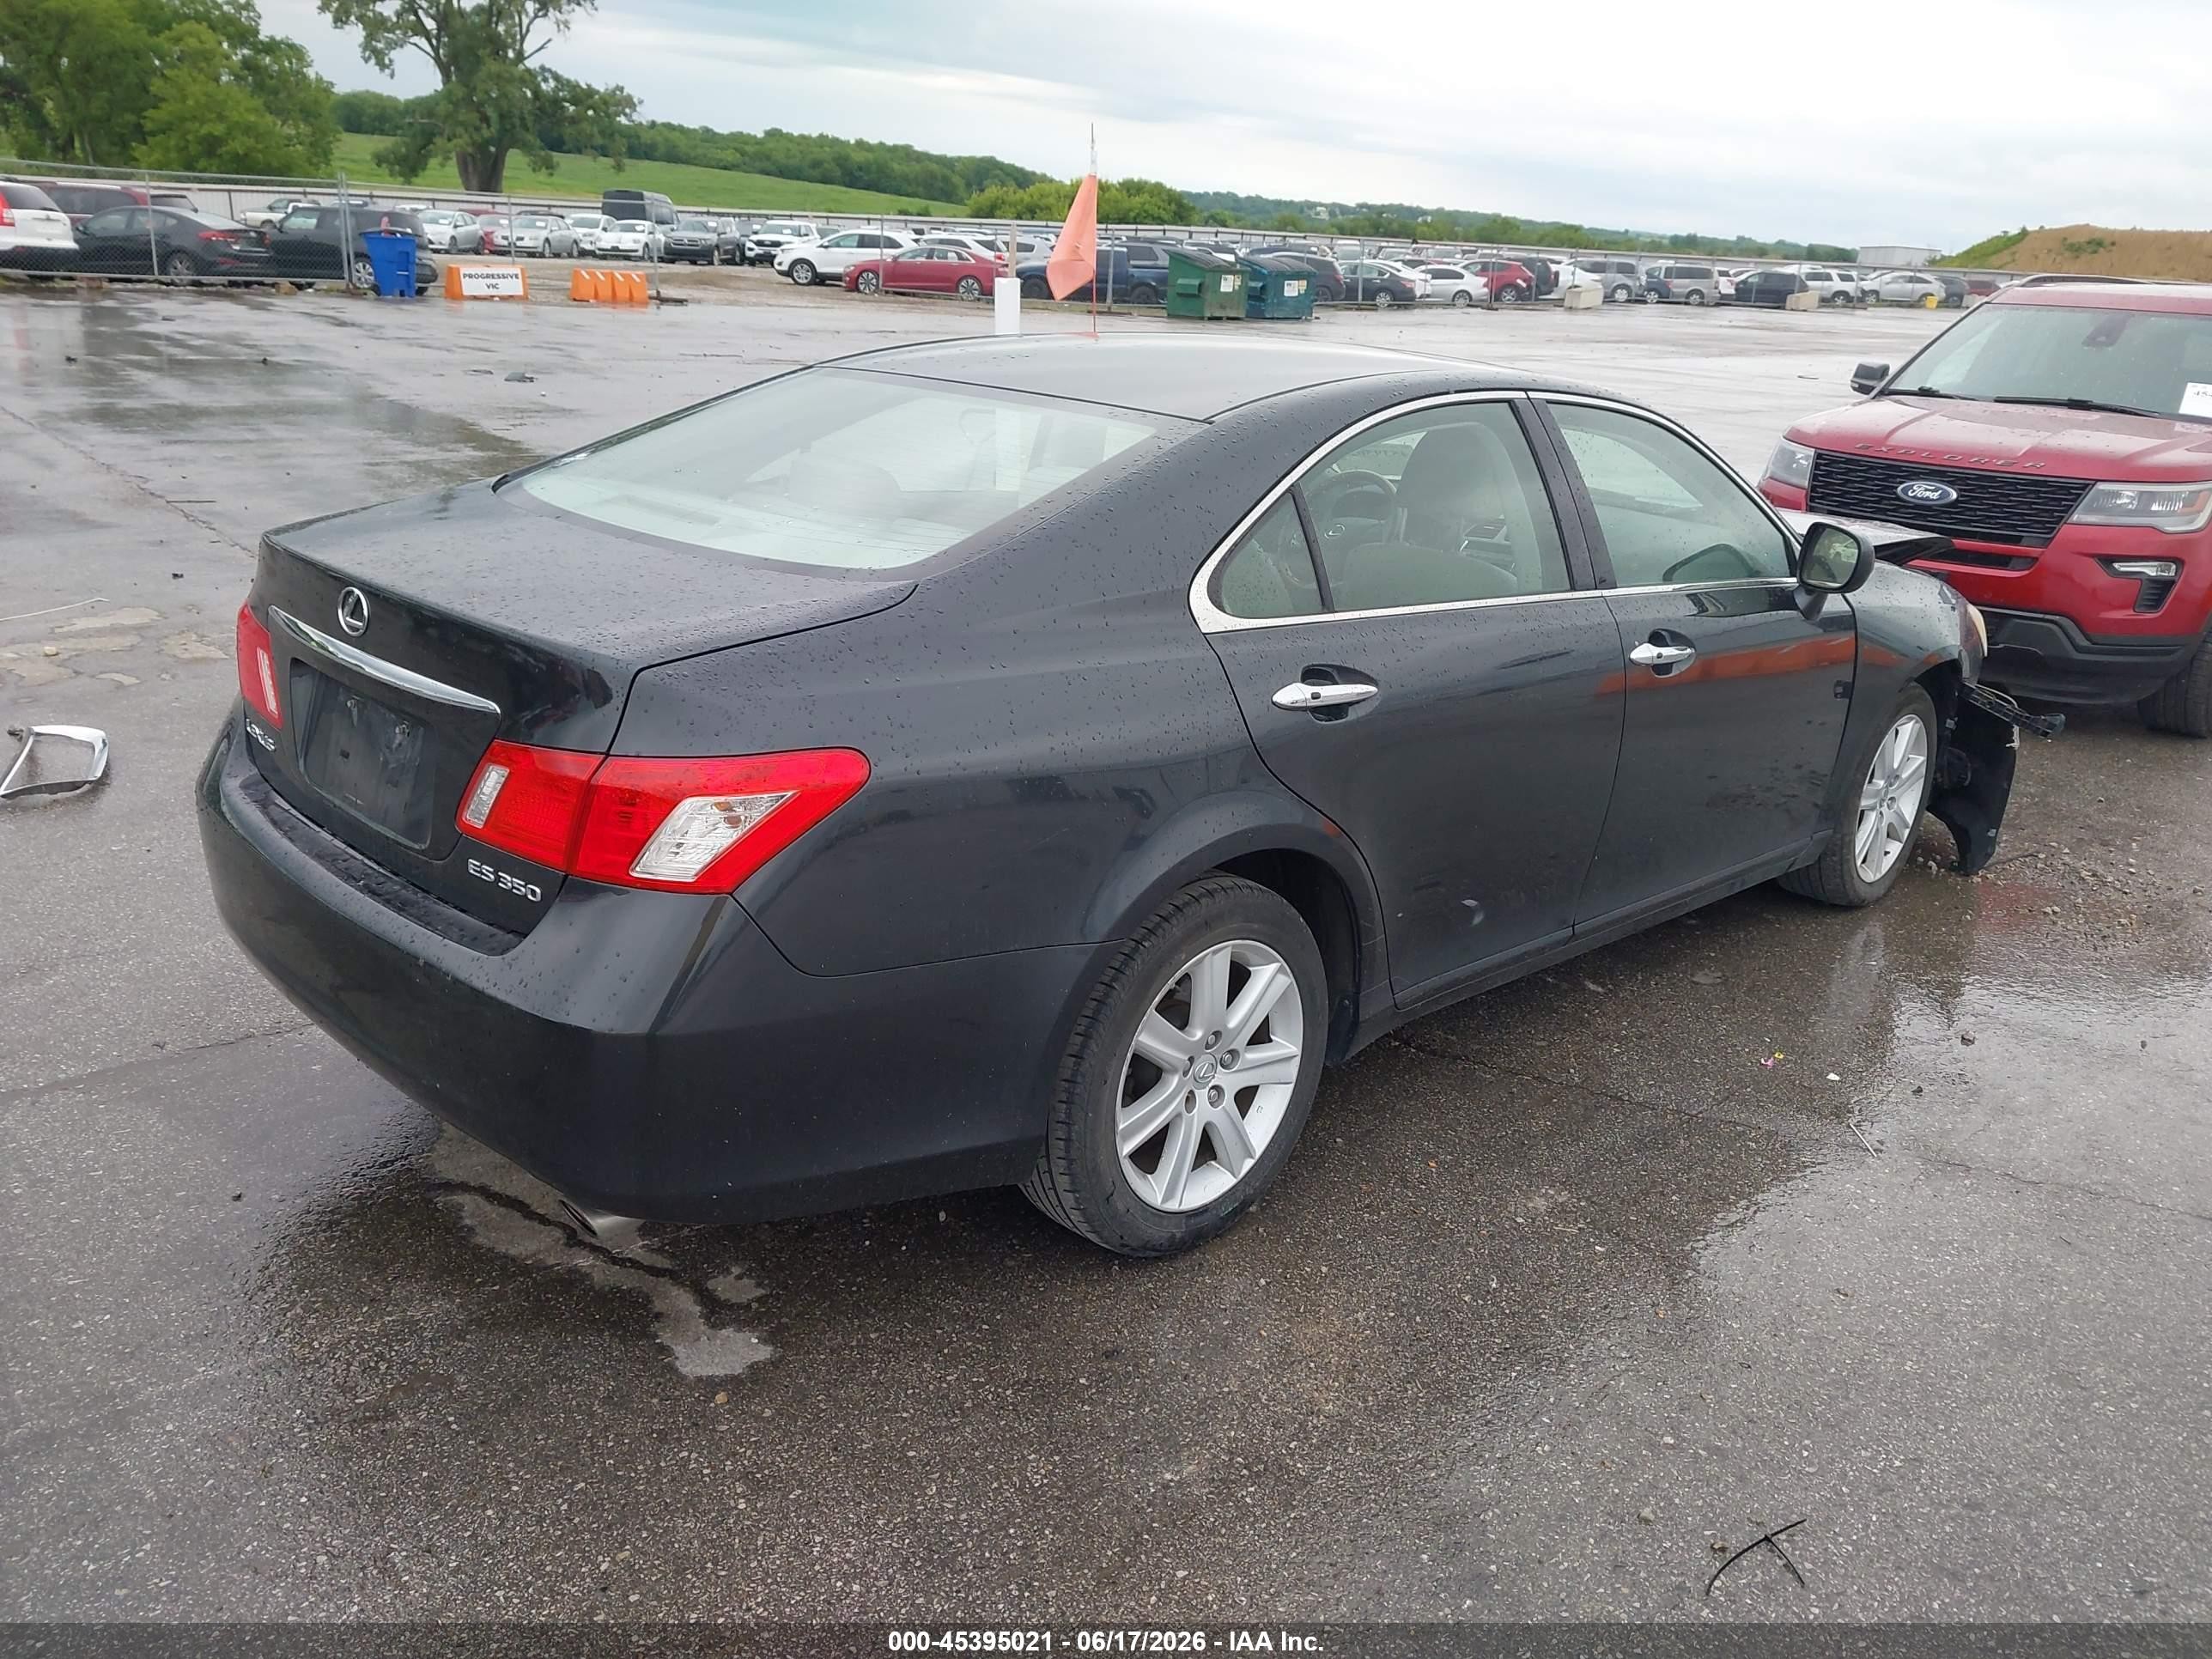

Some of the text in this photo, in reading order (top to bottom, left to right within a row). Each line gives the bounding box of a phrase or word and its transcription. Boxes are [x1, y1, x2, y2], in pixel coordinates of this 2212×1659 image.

[1854, 443, 2046, 469] EXPLORER
[1907, 484, 1943, 501] Ford
[246, 718, 276, 751] LEXUS
[467, 859, 542, 902] ES 350
